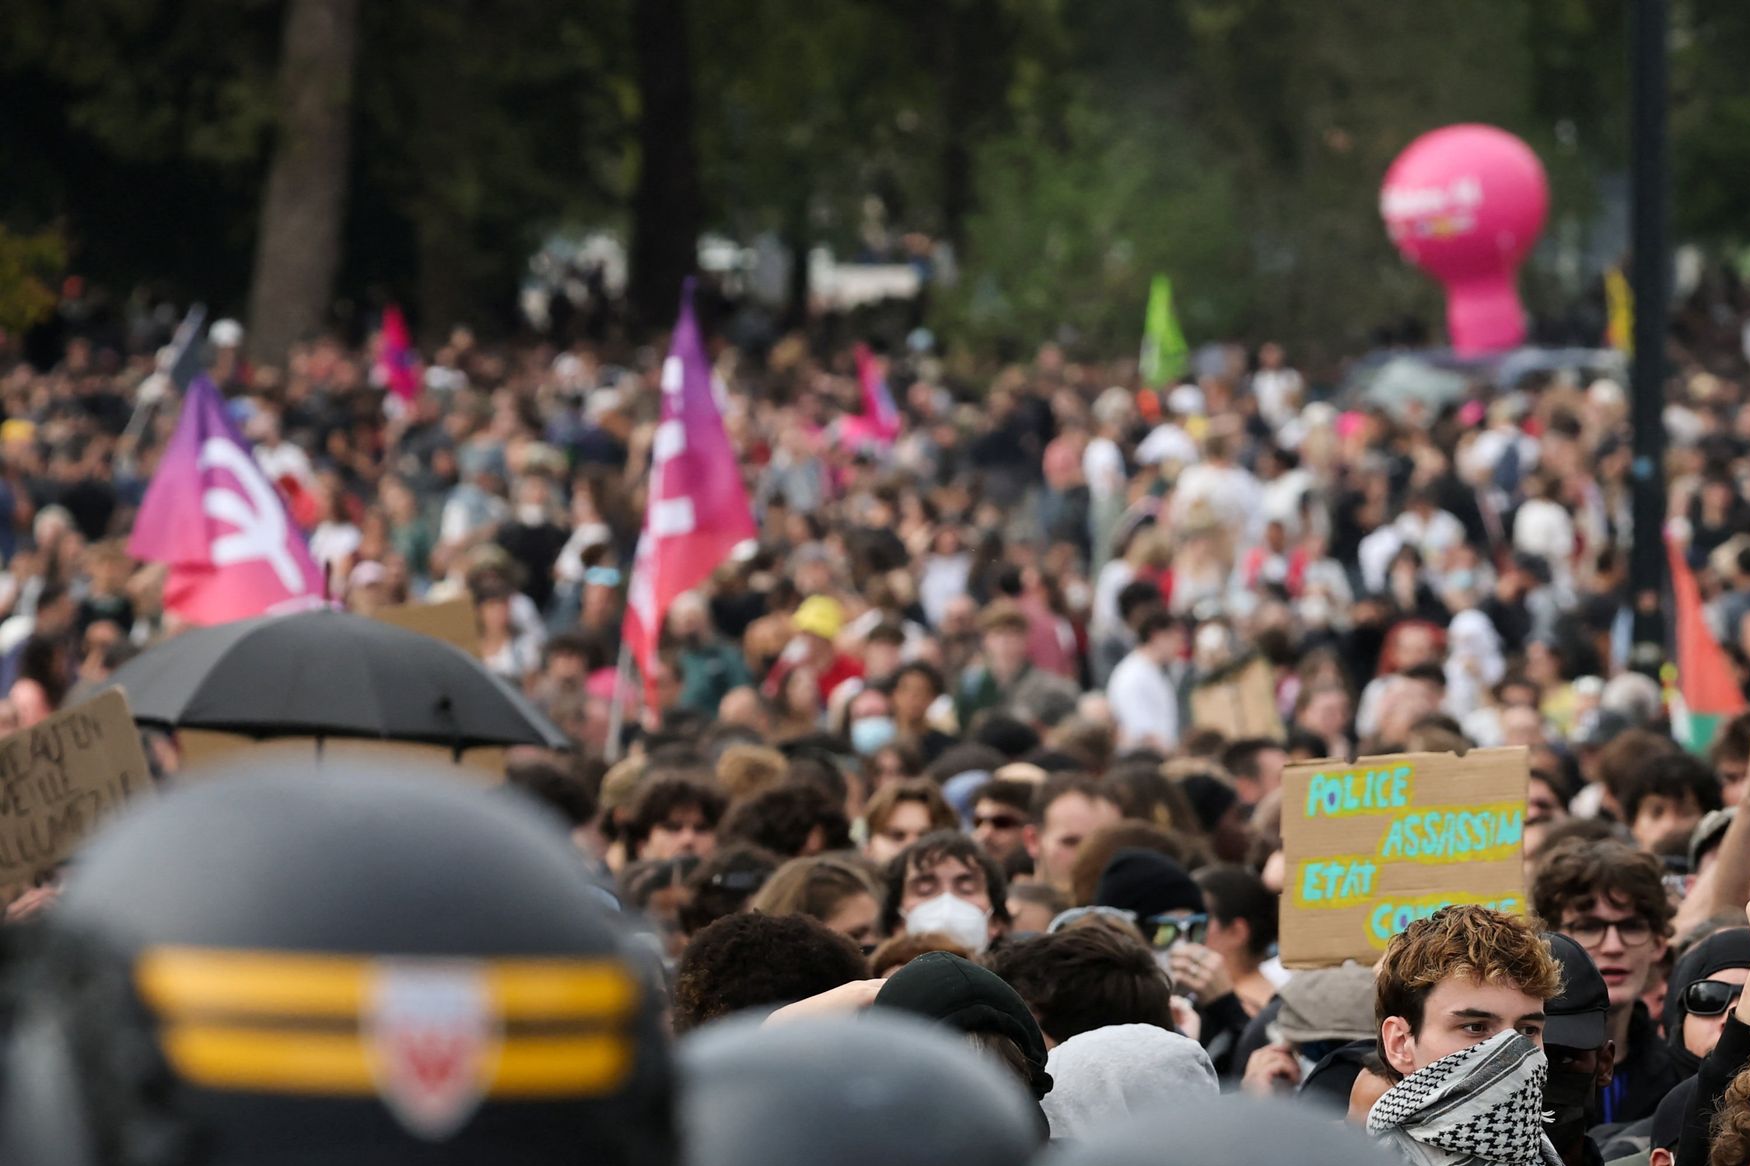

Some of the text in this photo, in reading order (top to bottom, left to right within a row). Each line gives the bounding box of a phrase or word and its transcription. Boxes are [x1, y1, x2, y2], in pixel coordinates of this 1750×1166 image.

[1306, 766, 1412, 817] POLICE
[1382, 810, 1522, 857] ASSASSIN
[1303, 860, 1376, 901] ETAT
